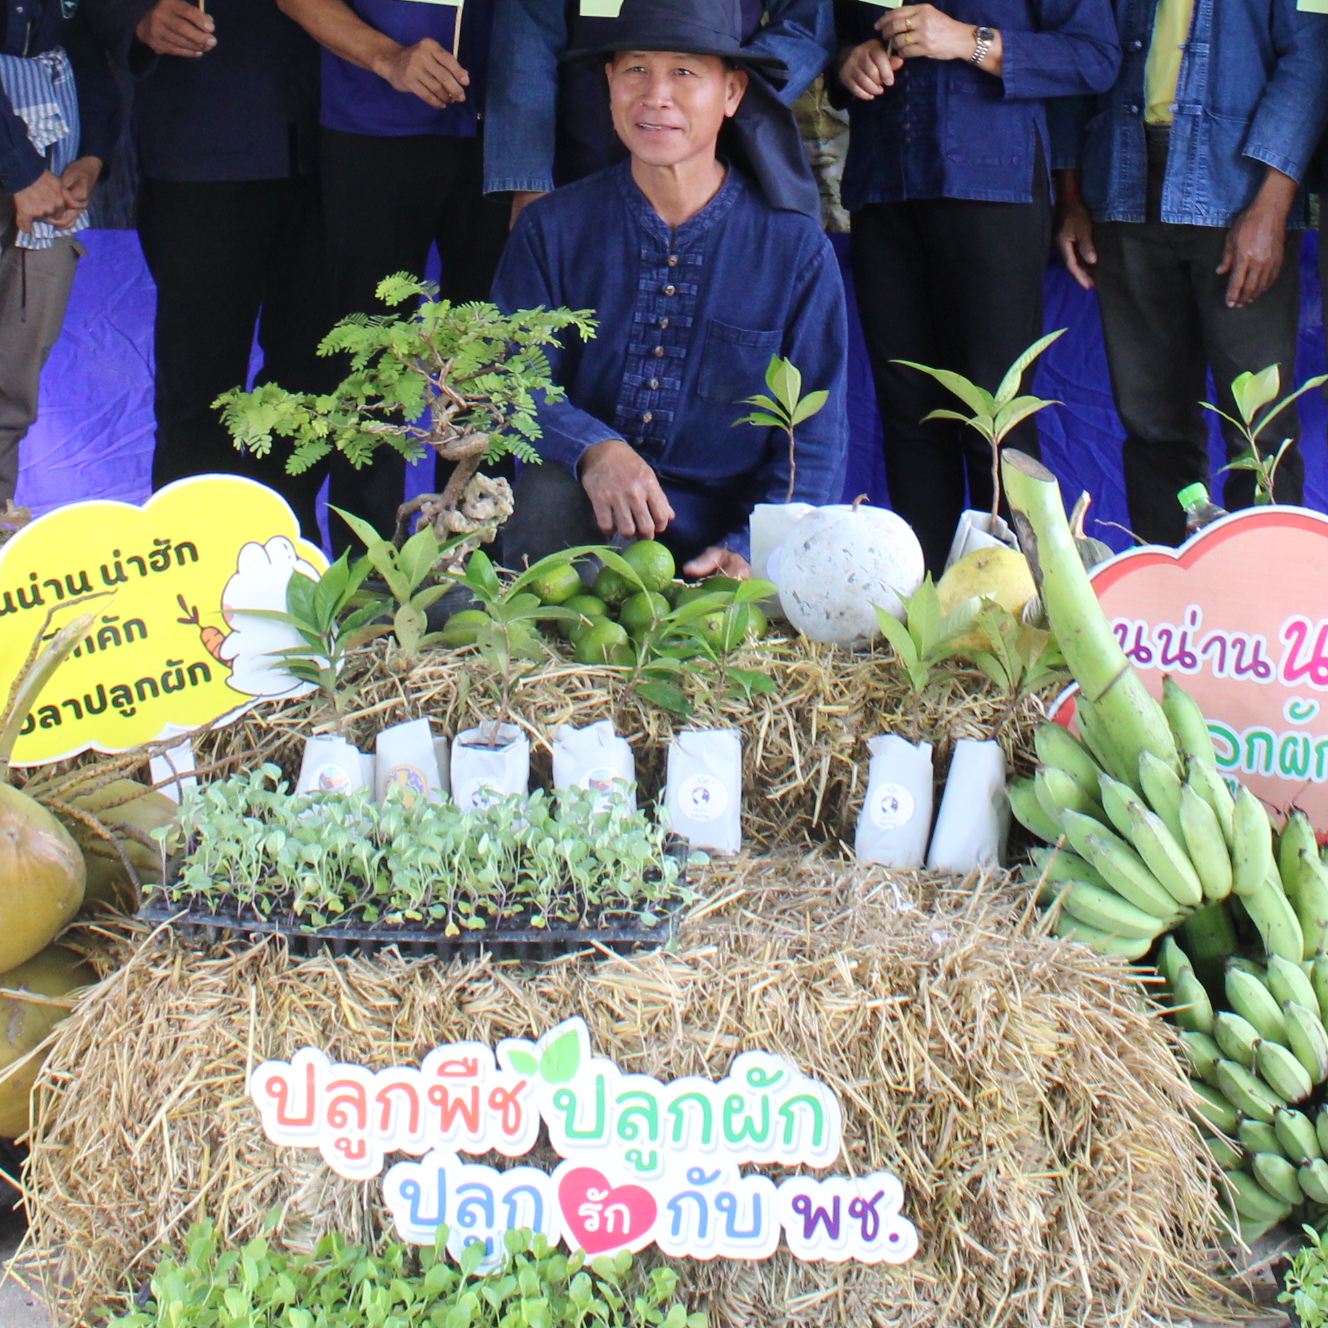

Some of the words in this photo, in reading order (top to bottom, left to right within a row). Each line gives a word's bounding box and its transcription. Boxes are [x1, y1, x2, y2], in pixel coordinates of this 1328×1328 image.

[101, 538, 199, 589] น่าฮัก
[264, 1056, 528, 1161] ปลูกพืช
[552, 1066, 824, 1171] ปลูกผัก
[576, 1188, 630, 1236] รัก
[666, 1165, 762, 1240] กับ
[792, 1187, 902, 1244] พช.
